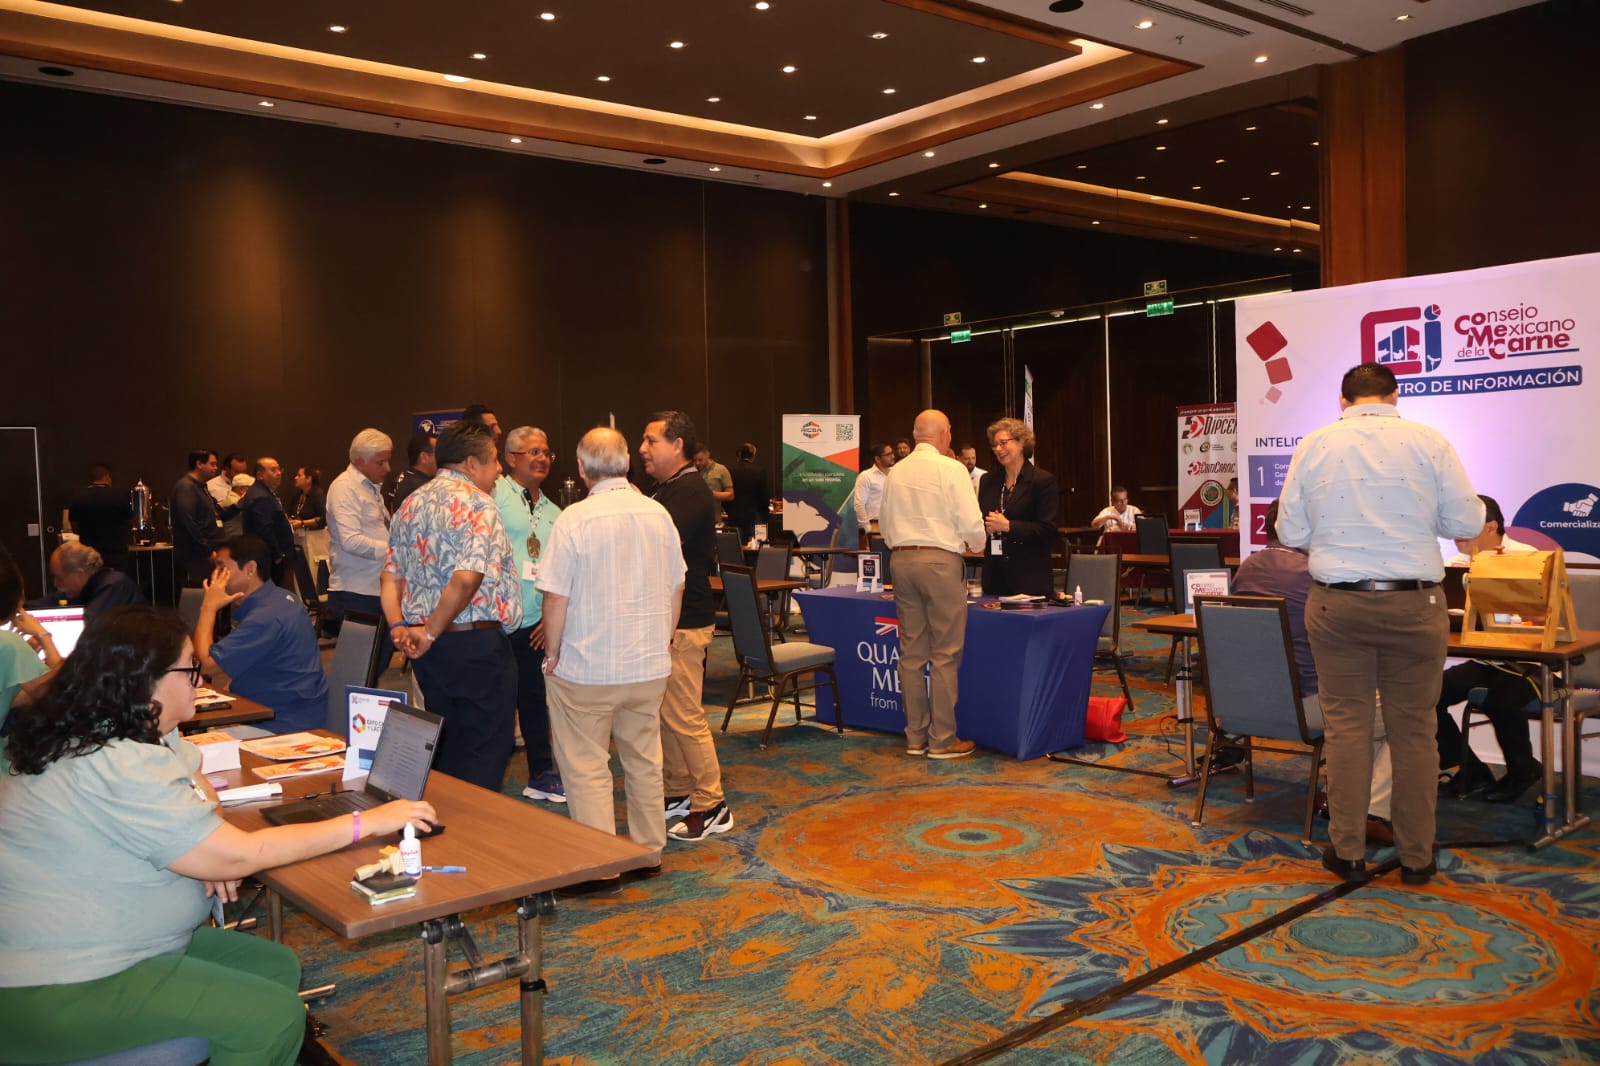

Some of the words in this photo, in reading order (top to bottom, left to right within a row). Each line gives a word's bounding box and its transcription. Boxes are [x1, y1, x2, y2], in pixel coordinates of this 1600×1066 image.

[1454, 303, 1539, 335] Consejo
[1466, 319, 1576, 348] Mexicano
[1457, 347, 1473, 357] de
[1475, 346, 1485, 357] la
[1488, 333, 1570, 360] Carne
[1431, 380, 1453, 393] DE
[1457, 369, 1579, 392] INFORMACIÓN
[1257, 466, 1264, 487] 1
[1256, 515, 1267, 534] 2
[857, 641, 900, 665] QUA
[870, 692, 898, 711] from
